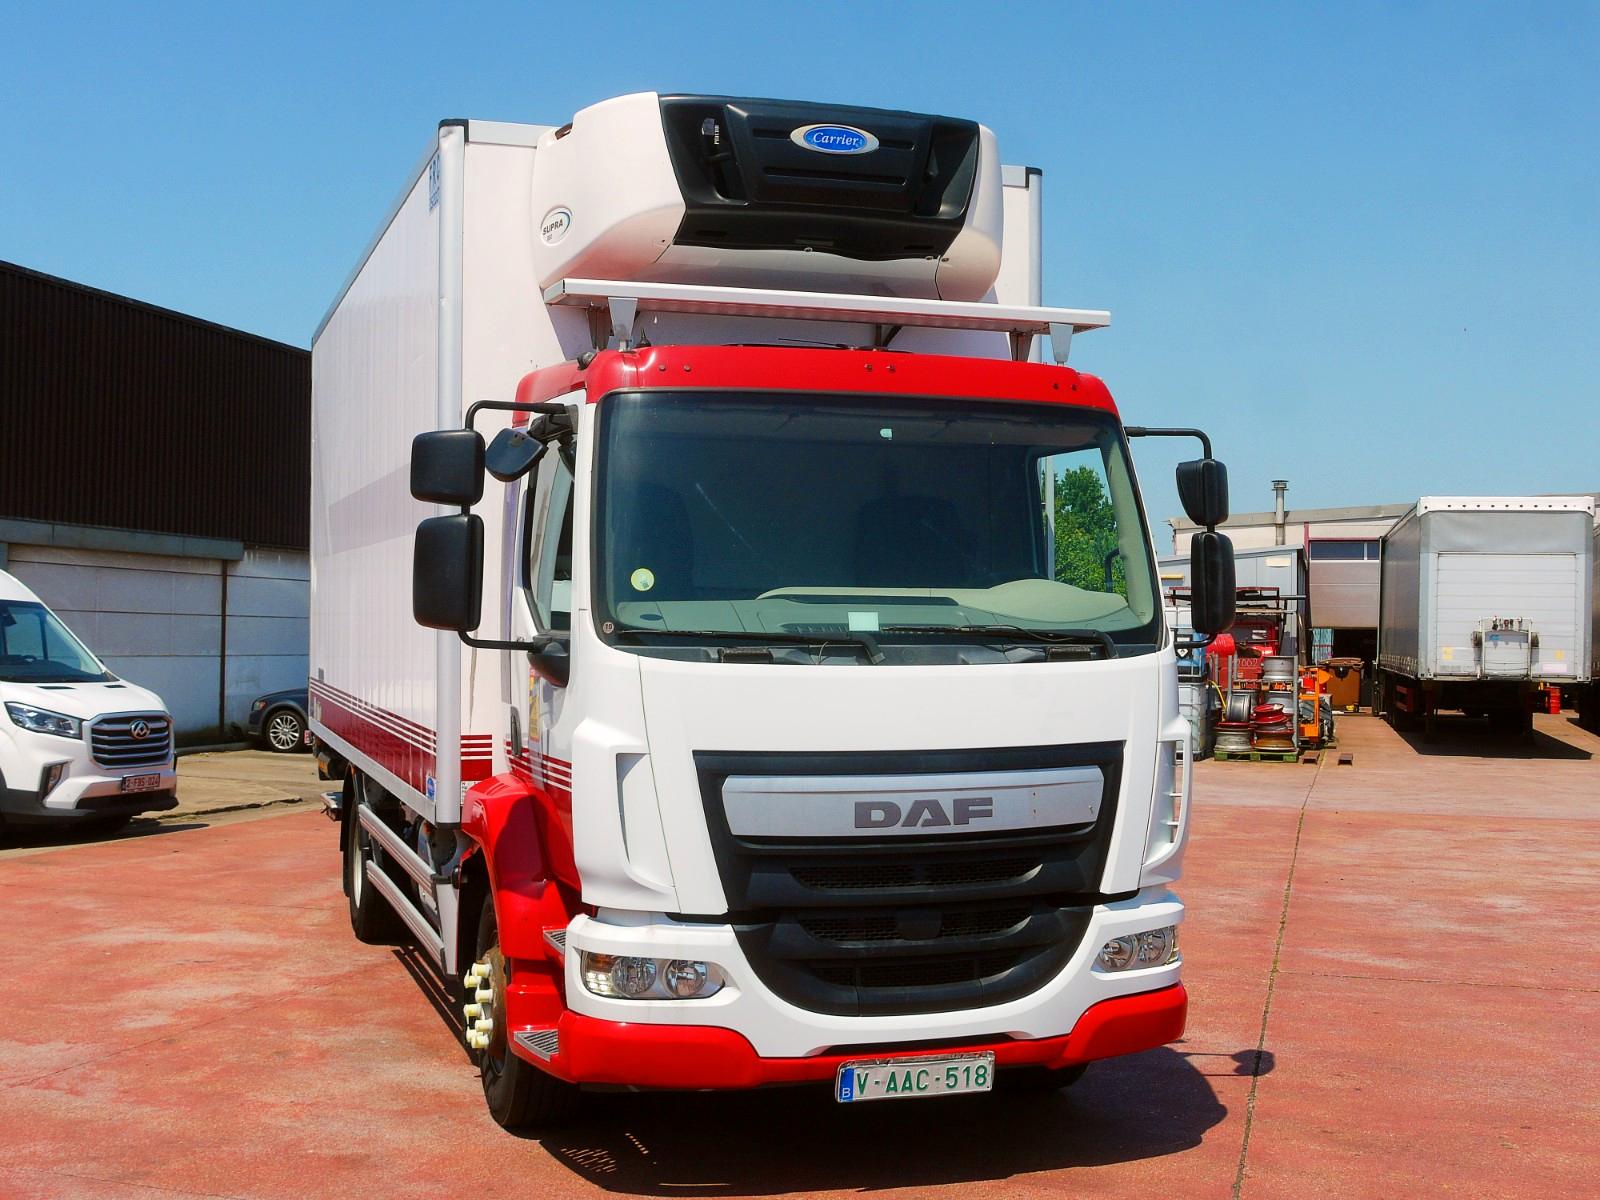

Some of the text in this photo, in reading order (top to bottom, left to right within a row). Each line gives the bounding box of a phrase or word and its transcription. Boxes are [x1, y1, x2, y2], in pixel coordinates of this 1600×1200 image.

[813, 132, 859, 146] Carrier
[542, 219, 563, 236] SUPRA
[854, 797, 993, 828] DAF
[842, 1087, 851, 1098] B
